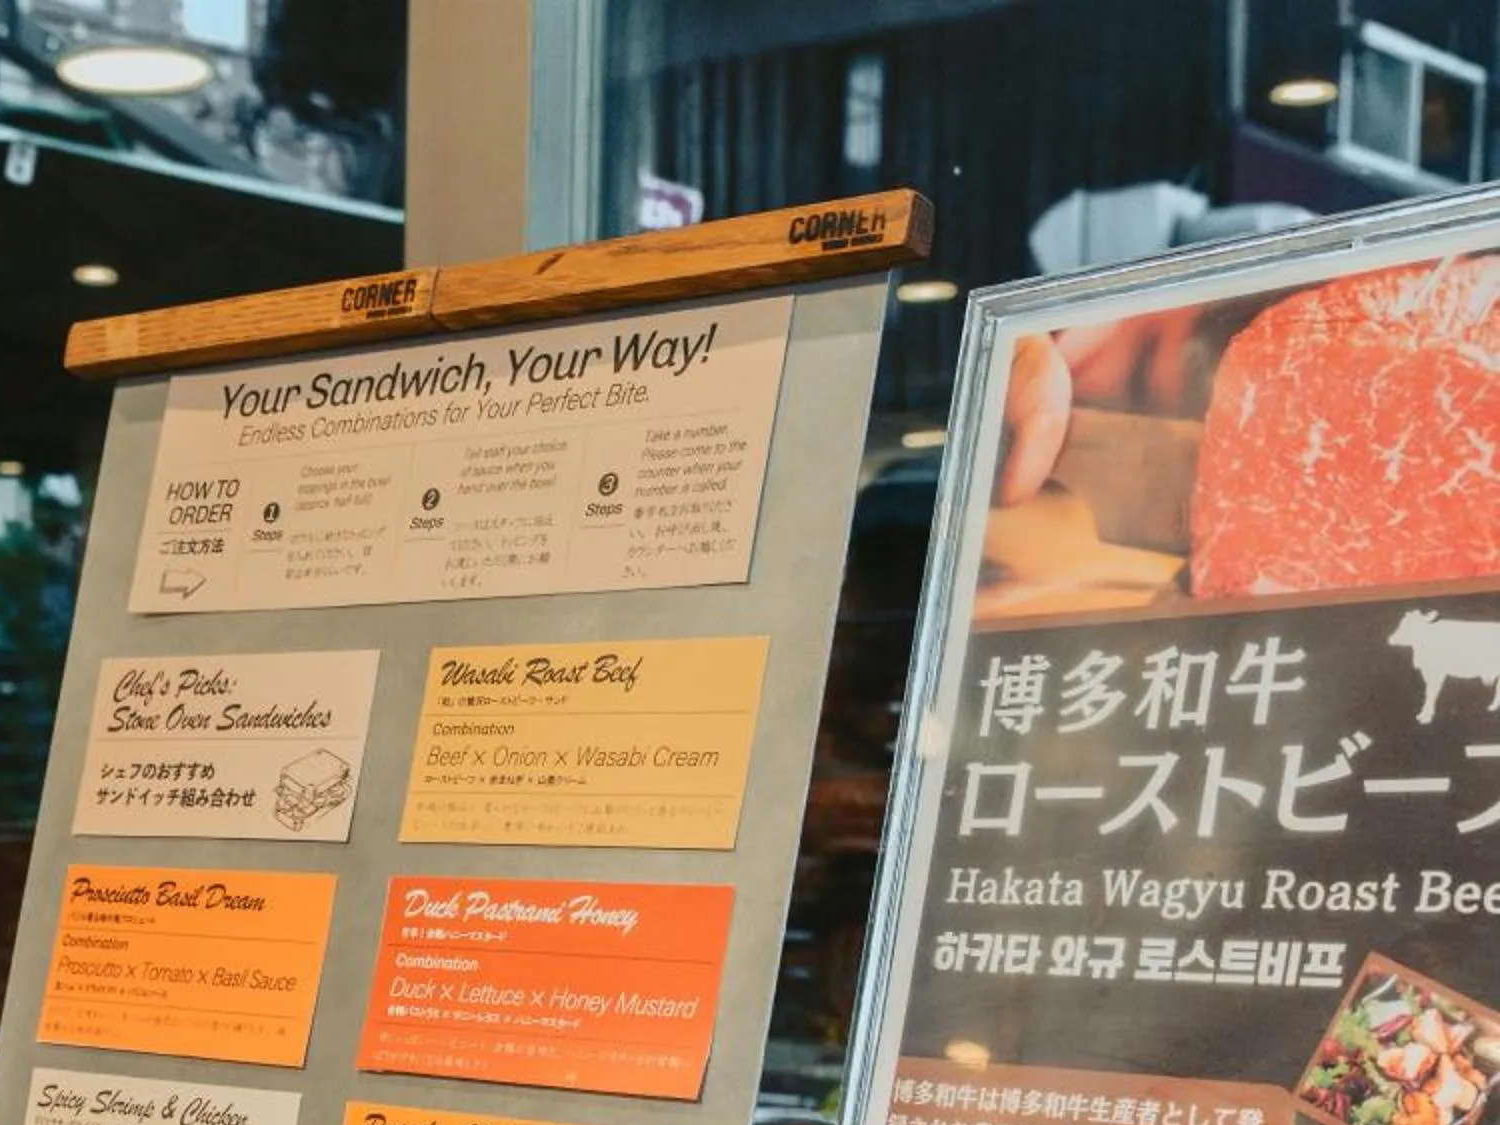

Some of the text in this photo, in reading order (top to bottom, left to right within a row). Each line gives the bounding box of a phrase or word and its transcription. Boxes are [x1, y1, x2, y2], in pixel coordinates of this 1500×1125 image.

[341, 279, 417, 312] CORNER
[223, 323, 718, 420] Your Sandwich, Your Way!
[238, 381, 650, 447] Endless Combinations for Your Perfect Bite.
[166, 479, 241, 501] HOW TO
[169, 504, 233, 525] ORDER
[409, 517, 445, 531] Steps
[584, 502, 624, 518] Steps
[160, 537, 224, 556] ご注文方法
[251, 529, 284, 543] Steps
[112, 668, 238, 706] Chef's Picks:
[440, 653, 645, 693] Wasabi Roast Beef
[978, 636, 1307, 737] 博多和牛
[107, 700, 333, 733] Stone Oven Sandwiches
[432, 722, 516, 738] Combination
[100, 762, 216, 781] シェフのおすすめ
[426, 744, 471, 768] Beef
[492, 744, 548, 768] Onion
[575, 744, 648, 768] Wasabi
[652, 745, 721, 769] Cream
[95, 787, 257, 808] サンドイッチ組み合わせ
[70, 877, 267, 912] Prosciutto Basil Dream
[946, 867, 1084, 908] Hakata
[1102, 868, 1244, 920] Wagyu
[1260, 869, 1400, 914] Roast
[404, 889, 640, 936] Duck Pastrami Honey
[62, 934, 129, 951] Combination
[395, 953, 479, 973] Combination
[933, 932, 1348, 988] 하카타 와규 로스트비프
[140, 961, 194, 985] Tomato
[211, 966, 252, 988] Basil
[251, 969, 299, 992] Sauce
[389, 975, 435, 1000] Duck
[458, 979, 525, 1008] Lettuce
[548, 987, 612, 1017] Honey
[614, 991, 701, 1020] Mustard
[37, 1084, 85, 1116] Spicy
[90, 1089, 156, 1124] Shrimp
[161, 1095, 177, 1120] &
